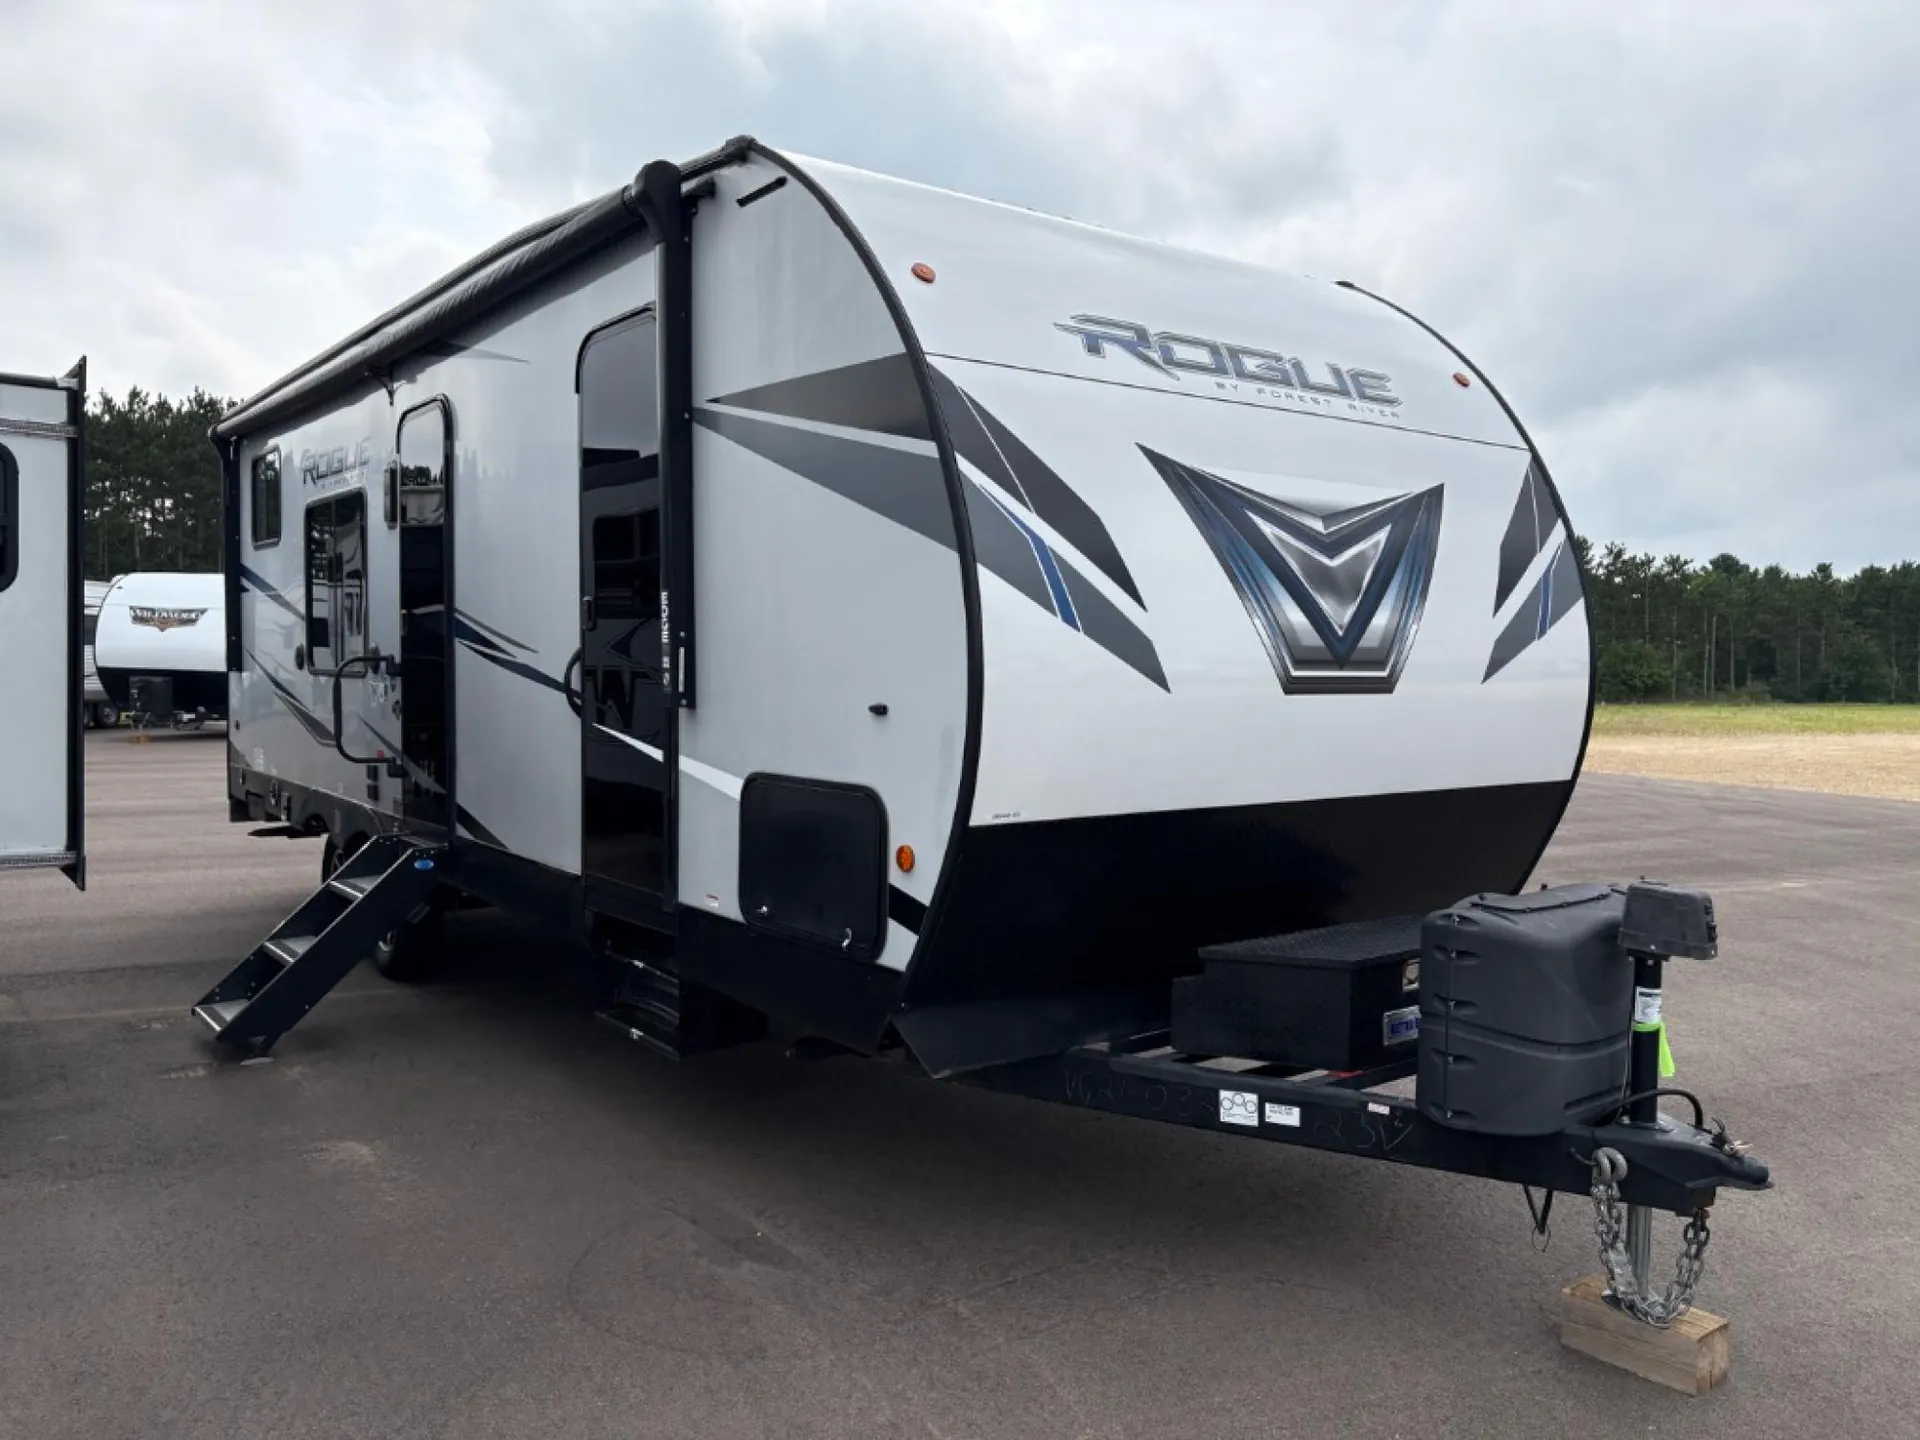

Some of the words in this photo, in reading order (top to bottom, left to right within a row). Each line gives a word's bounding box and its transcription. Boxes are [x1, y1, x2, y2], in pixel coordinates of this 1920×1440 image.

[1052, 313, 1403, 407] ROGUE
[1215, 381, 1239, 393] BY
[1257, 387, 1332, 407] FOREST
[1347, 402, 1400, 419] RIVER
[301, 436, 371, 486] ROGUE
